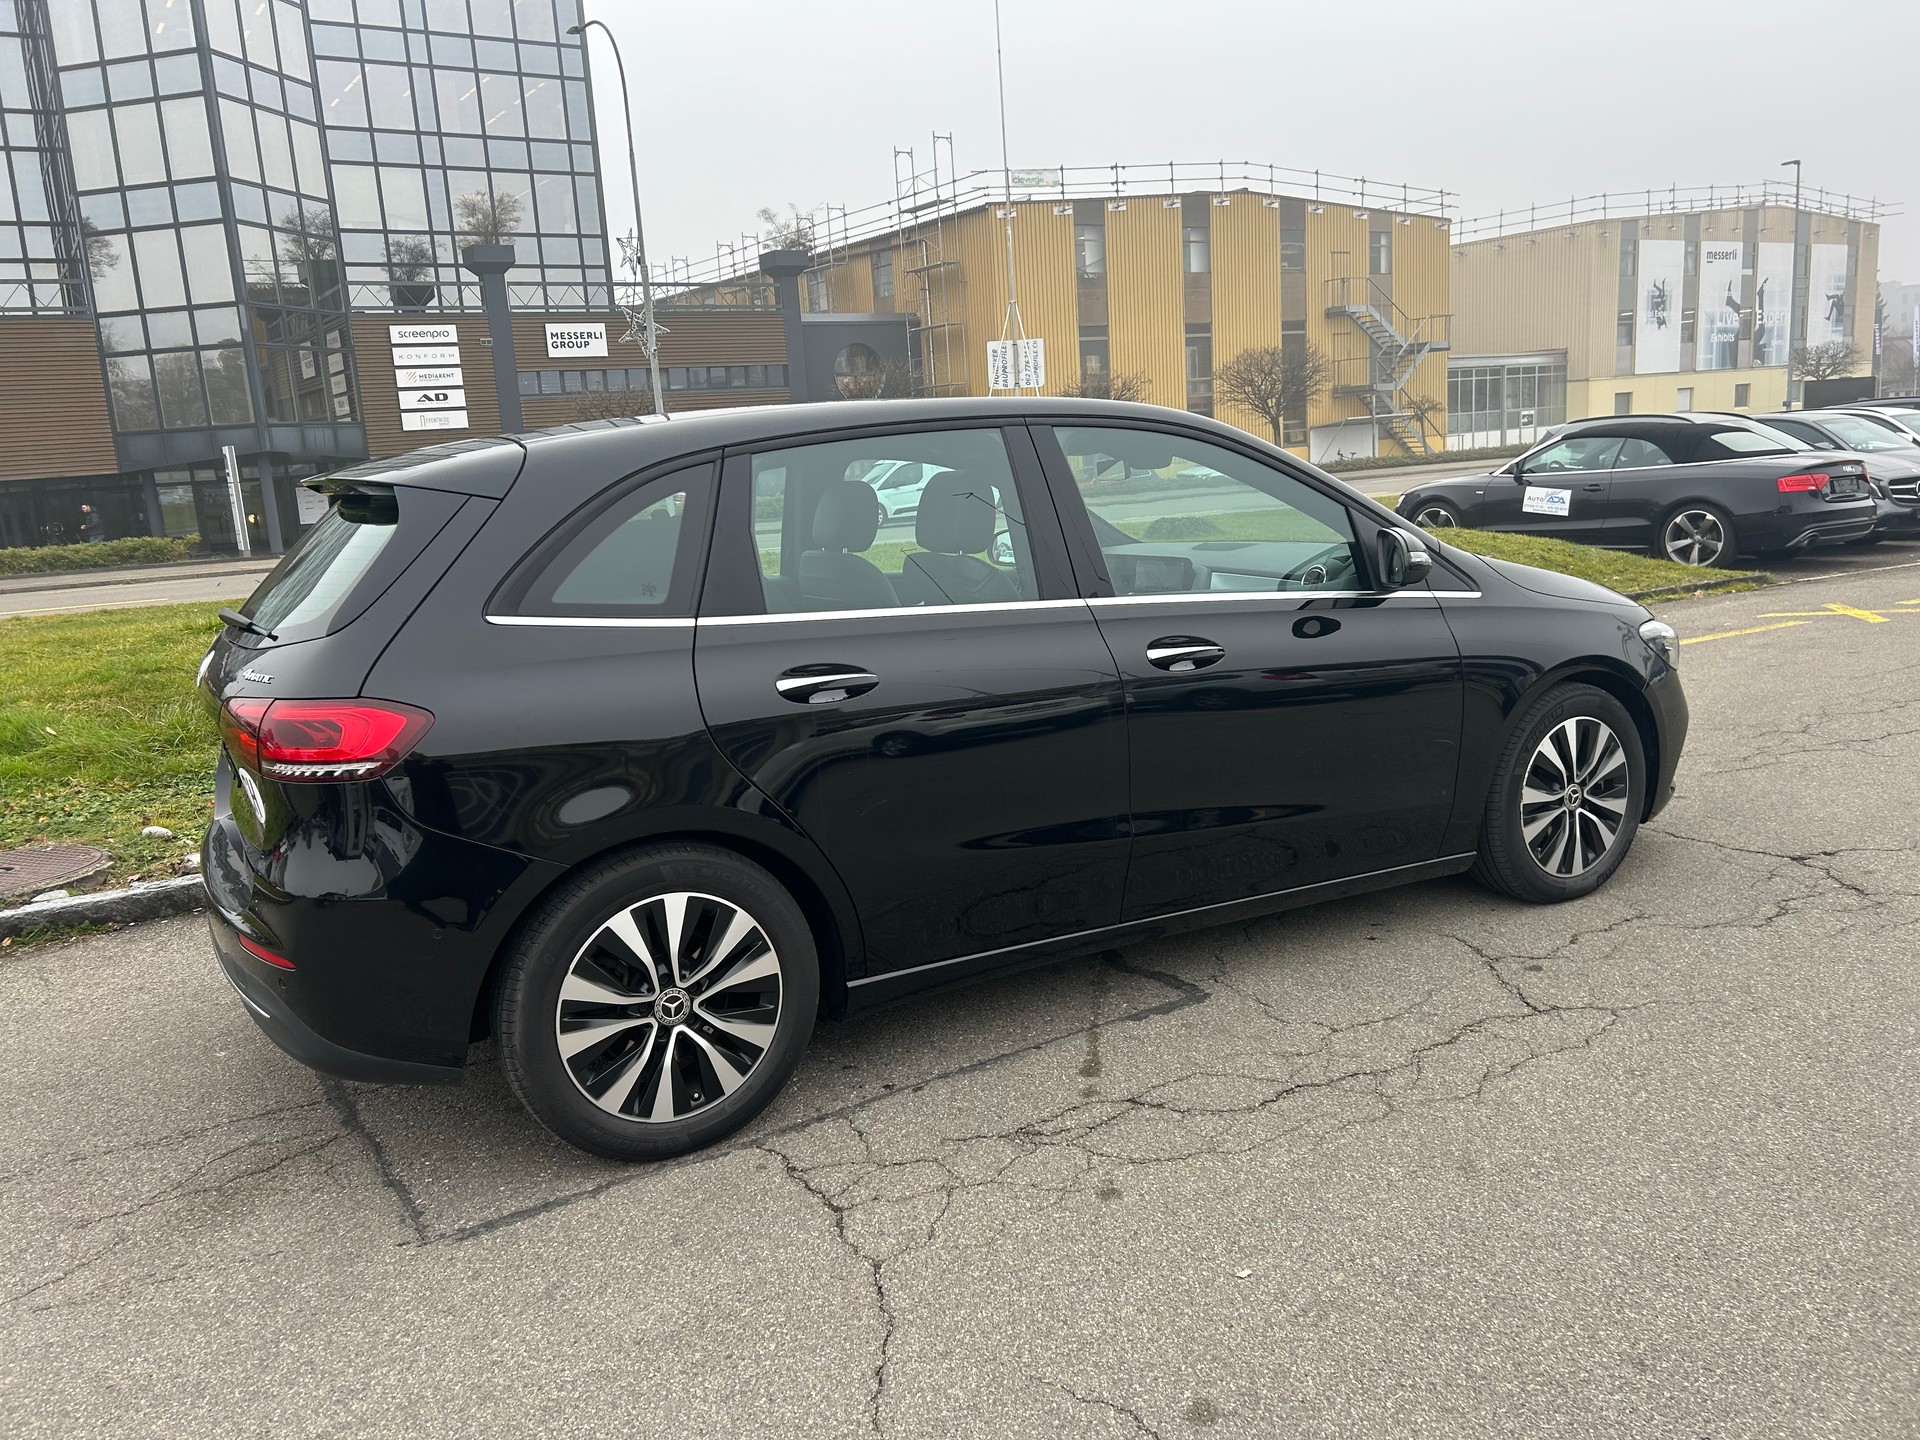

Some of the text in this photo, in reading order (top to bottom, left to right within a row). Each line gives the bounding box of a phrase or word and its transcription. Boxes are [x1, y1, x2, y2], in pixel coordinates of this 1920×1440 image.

[1706, 249, 1738, 260] messerli
[1717, 311, 1740, 325] Live
[397, 330, 450, 339] screenpro
[550, 331, 603, 340] MESSERLI
[1710, 332, 1735, 343] Exhibits
[551, 340, 590, 349] GROUP
[418, 372, 455, 380] MEDIARENT
[416, 392, 449, 402] AD
